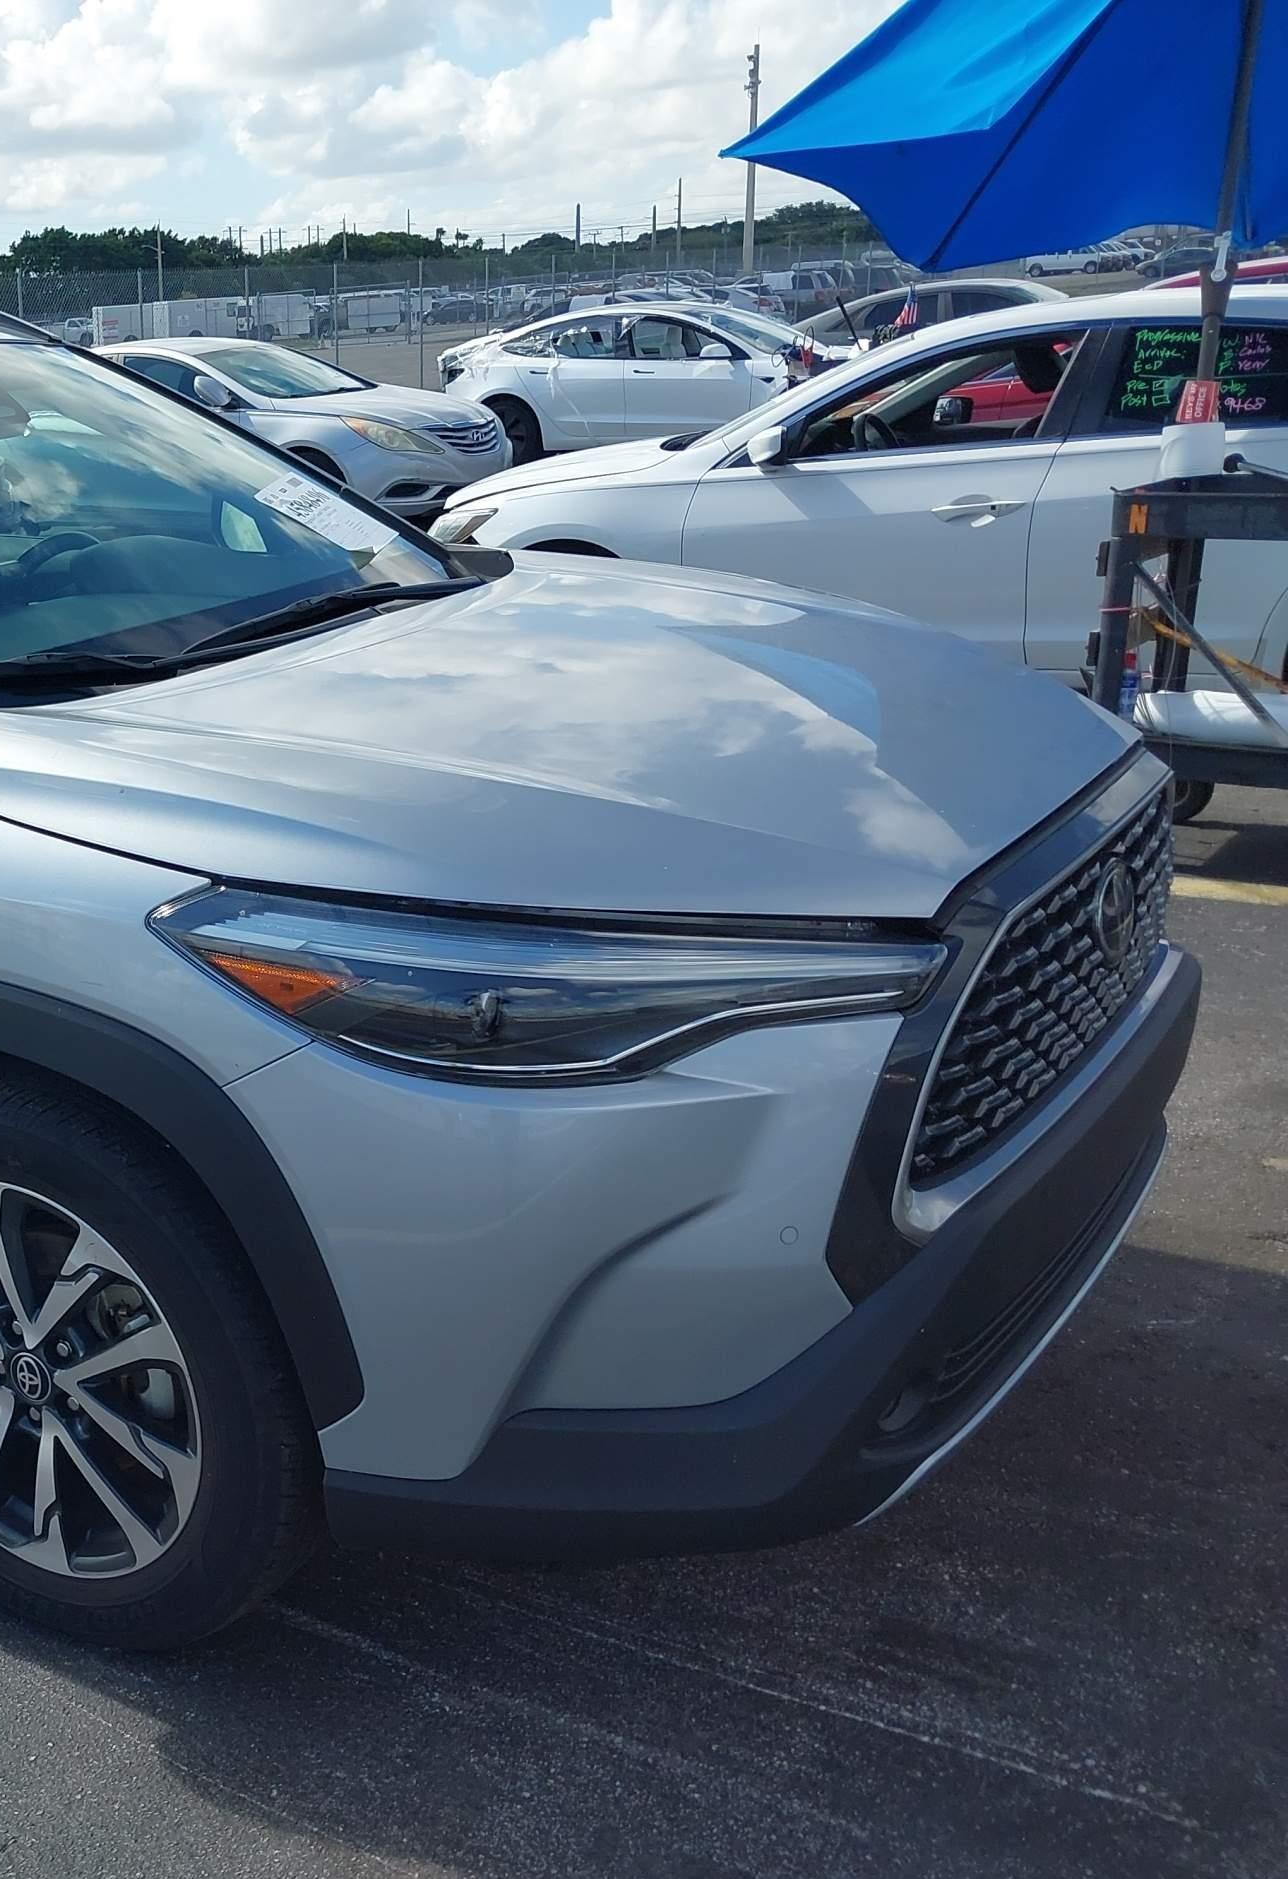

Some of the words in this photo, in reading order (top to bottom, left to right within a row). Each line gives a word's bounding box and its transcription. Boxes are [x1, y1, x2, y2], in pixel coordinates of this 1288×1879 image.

[1121, 393, 1147, 411] Post
[1194, 386, 1207, 418] OFFICE
[1224, 397, 1267, 414] 9468
